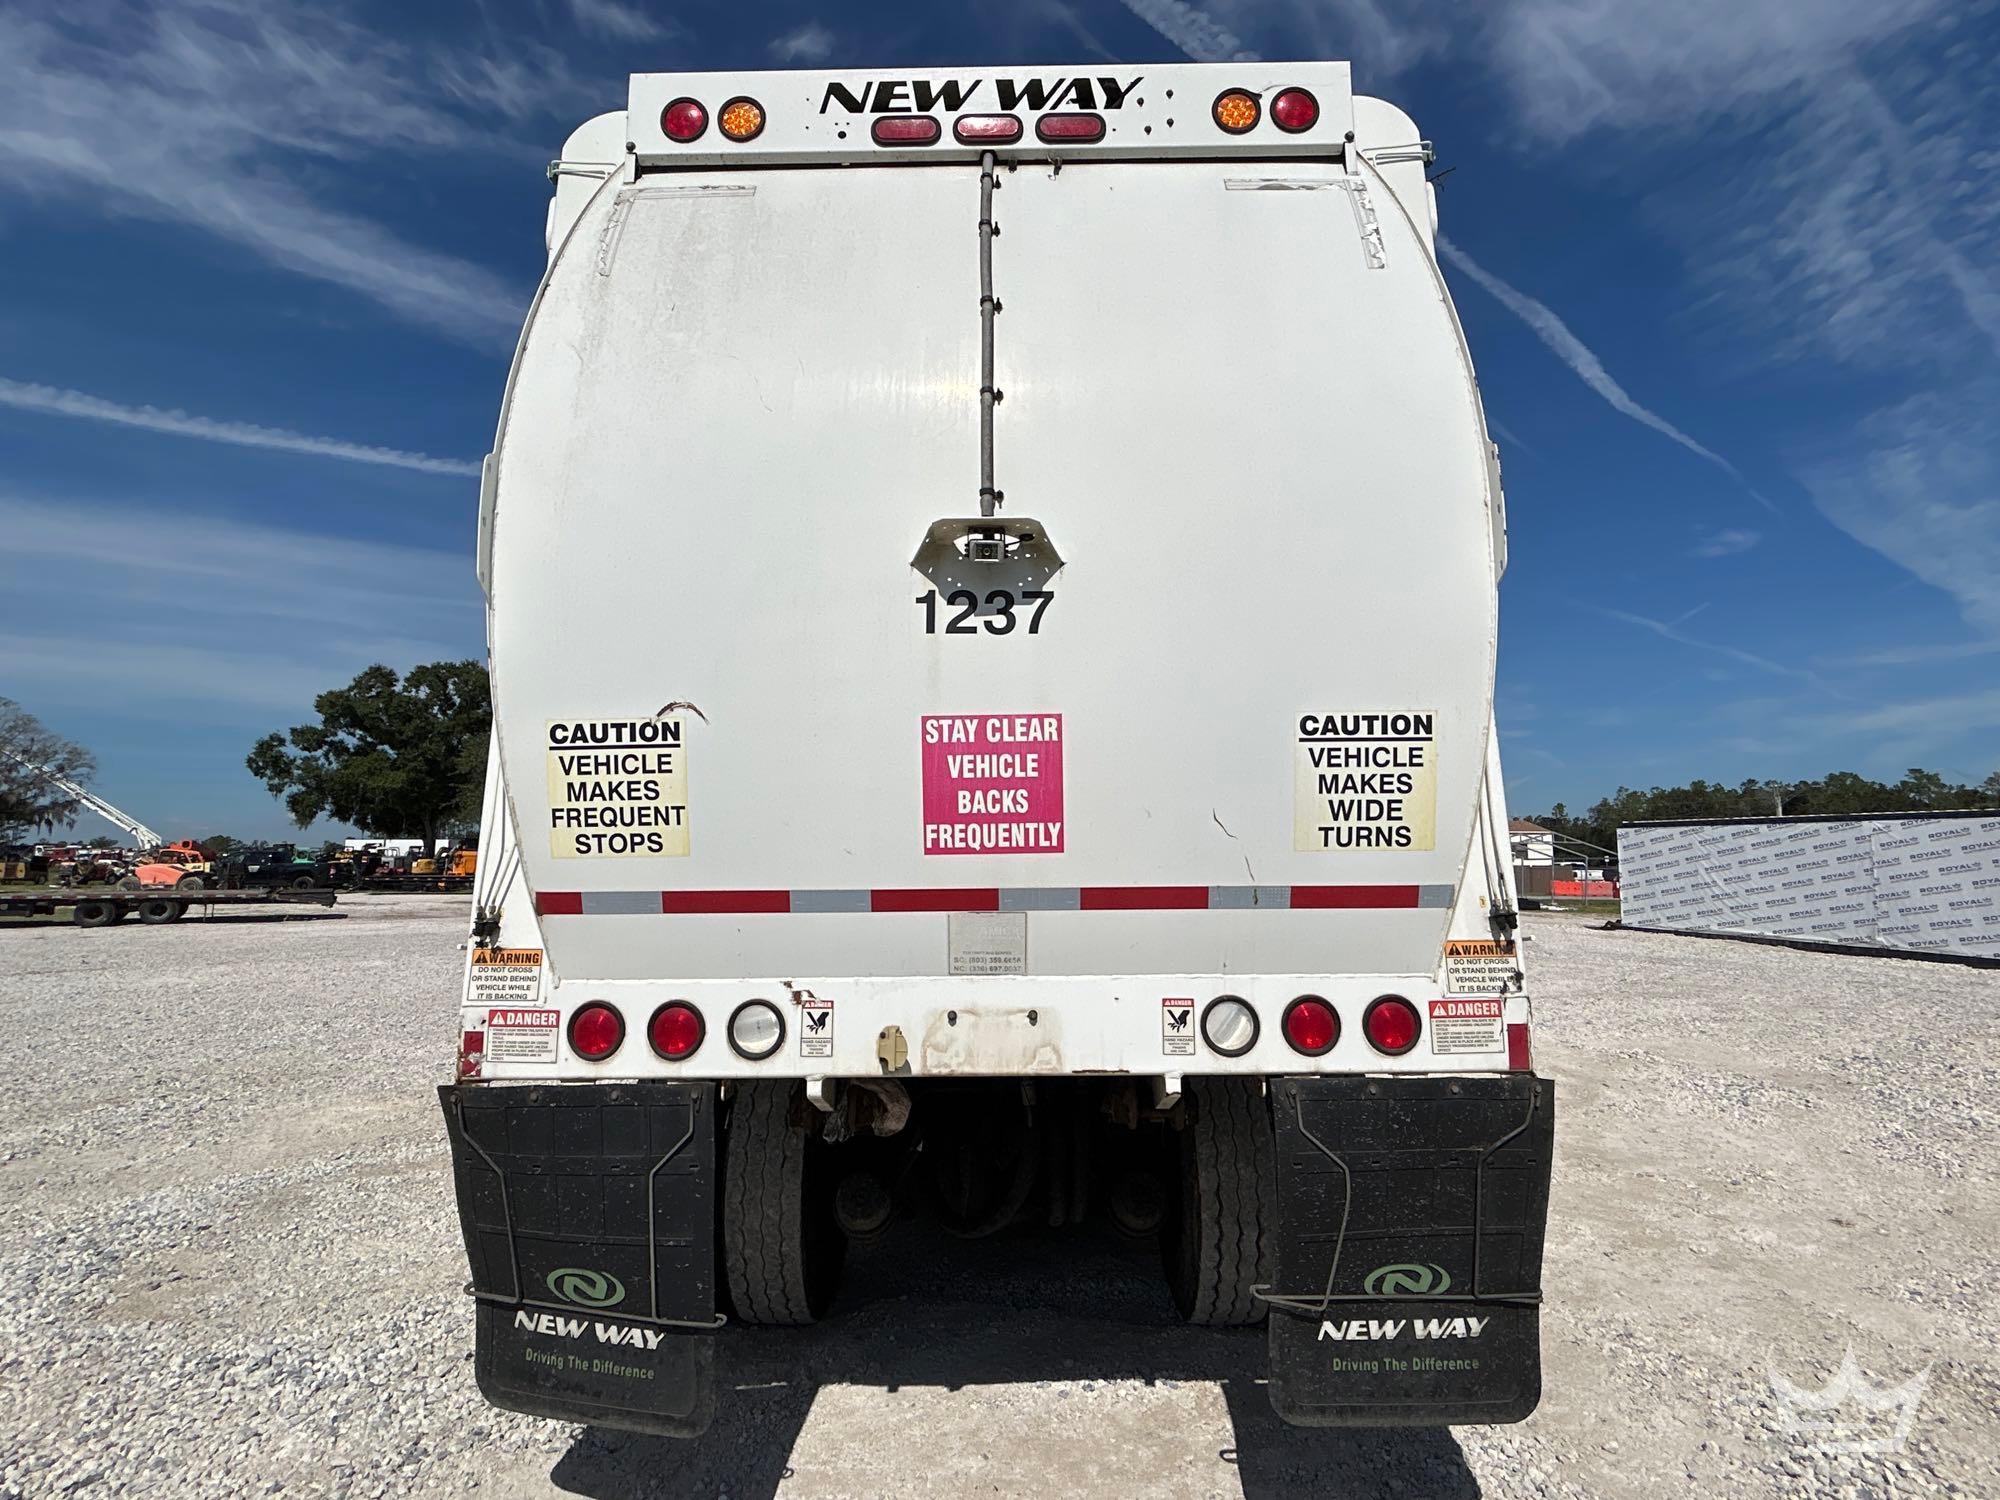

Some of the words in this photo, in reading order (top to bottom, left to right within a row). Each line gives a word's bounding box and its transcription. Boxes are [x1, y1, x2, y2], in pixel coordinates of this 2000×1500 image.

[819, 80, 983, 114] NEW
[995, 77, 1145, 111] WAY
[915, 590, 1055, 635] 1237
[550, 722, 680, 744] CAUTION
[926, 719, 978, 743] STAY
[986, 717, 1058, 743] CLEAR
[1300, 715, 1432, 736] CAUTION
[559, 753, 672, 775] VEHICLE
[947, 753, 1039, 779] VEHICLE
[1309, 747, 1423, 767] VEHICLE
[567, 780, 659, 801] MAKES
[1319, 773, 1412, 794] MAKES
[958, 789, 1029, 814] BACKS
[1329, 799, 1403, 821] WIDE
[551, 806, 685, 828] FREQUENT
[575, 832, 663, 854] STOPS
[926, 822, 1061, 850] FREQUENTLY
[1318, 826, 1411, 847] TURNS
[1880, 839, 1907, 847] ROYAL
[1928, 830, 1960, 838] ROYAL
[1910, 851, 1941, 859] ROYAL
[1961, 841, 1992, 850] ROYAL
[1889, 872, 1919, 880] ROYAL
[1939, 864, 1970, 872] ROYAL
[1949, 899, 1982, 907] ROYAL
[489, 953, 539, 963] WARNING
[506, 1013, 557, 1025] DANGER
[1448, 1003, 1498, 1015] DANGER
[514, 1311, 589, 1339] NEW
[595, 1323, 666, 1350] WAY
[1318, 1320, 1406, 1341] NEW
[1413, 1317, 1489, 1339] WAY
[526, 1348, 564, 1370] Driving
[568, 1356, 589, 1370] The
[593, 1360, 655, 1380] Difference
[1333, 1358, 1378, 1373] Driving
[1384, 1358, 1408, 1370] The
[1413, 1358, 1480, 1371] Difference
